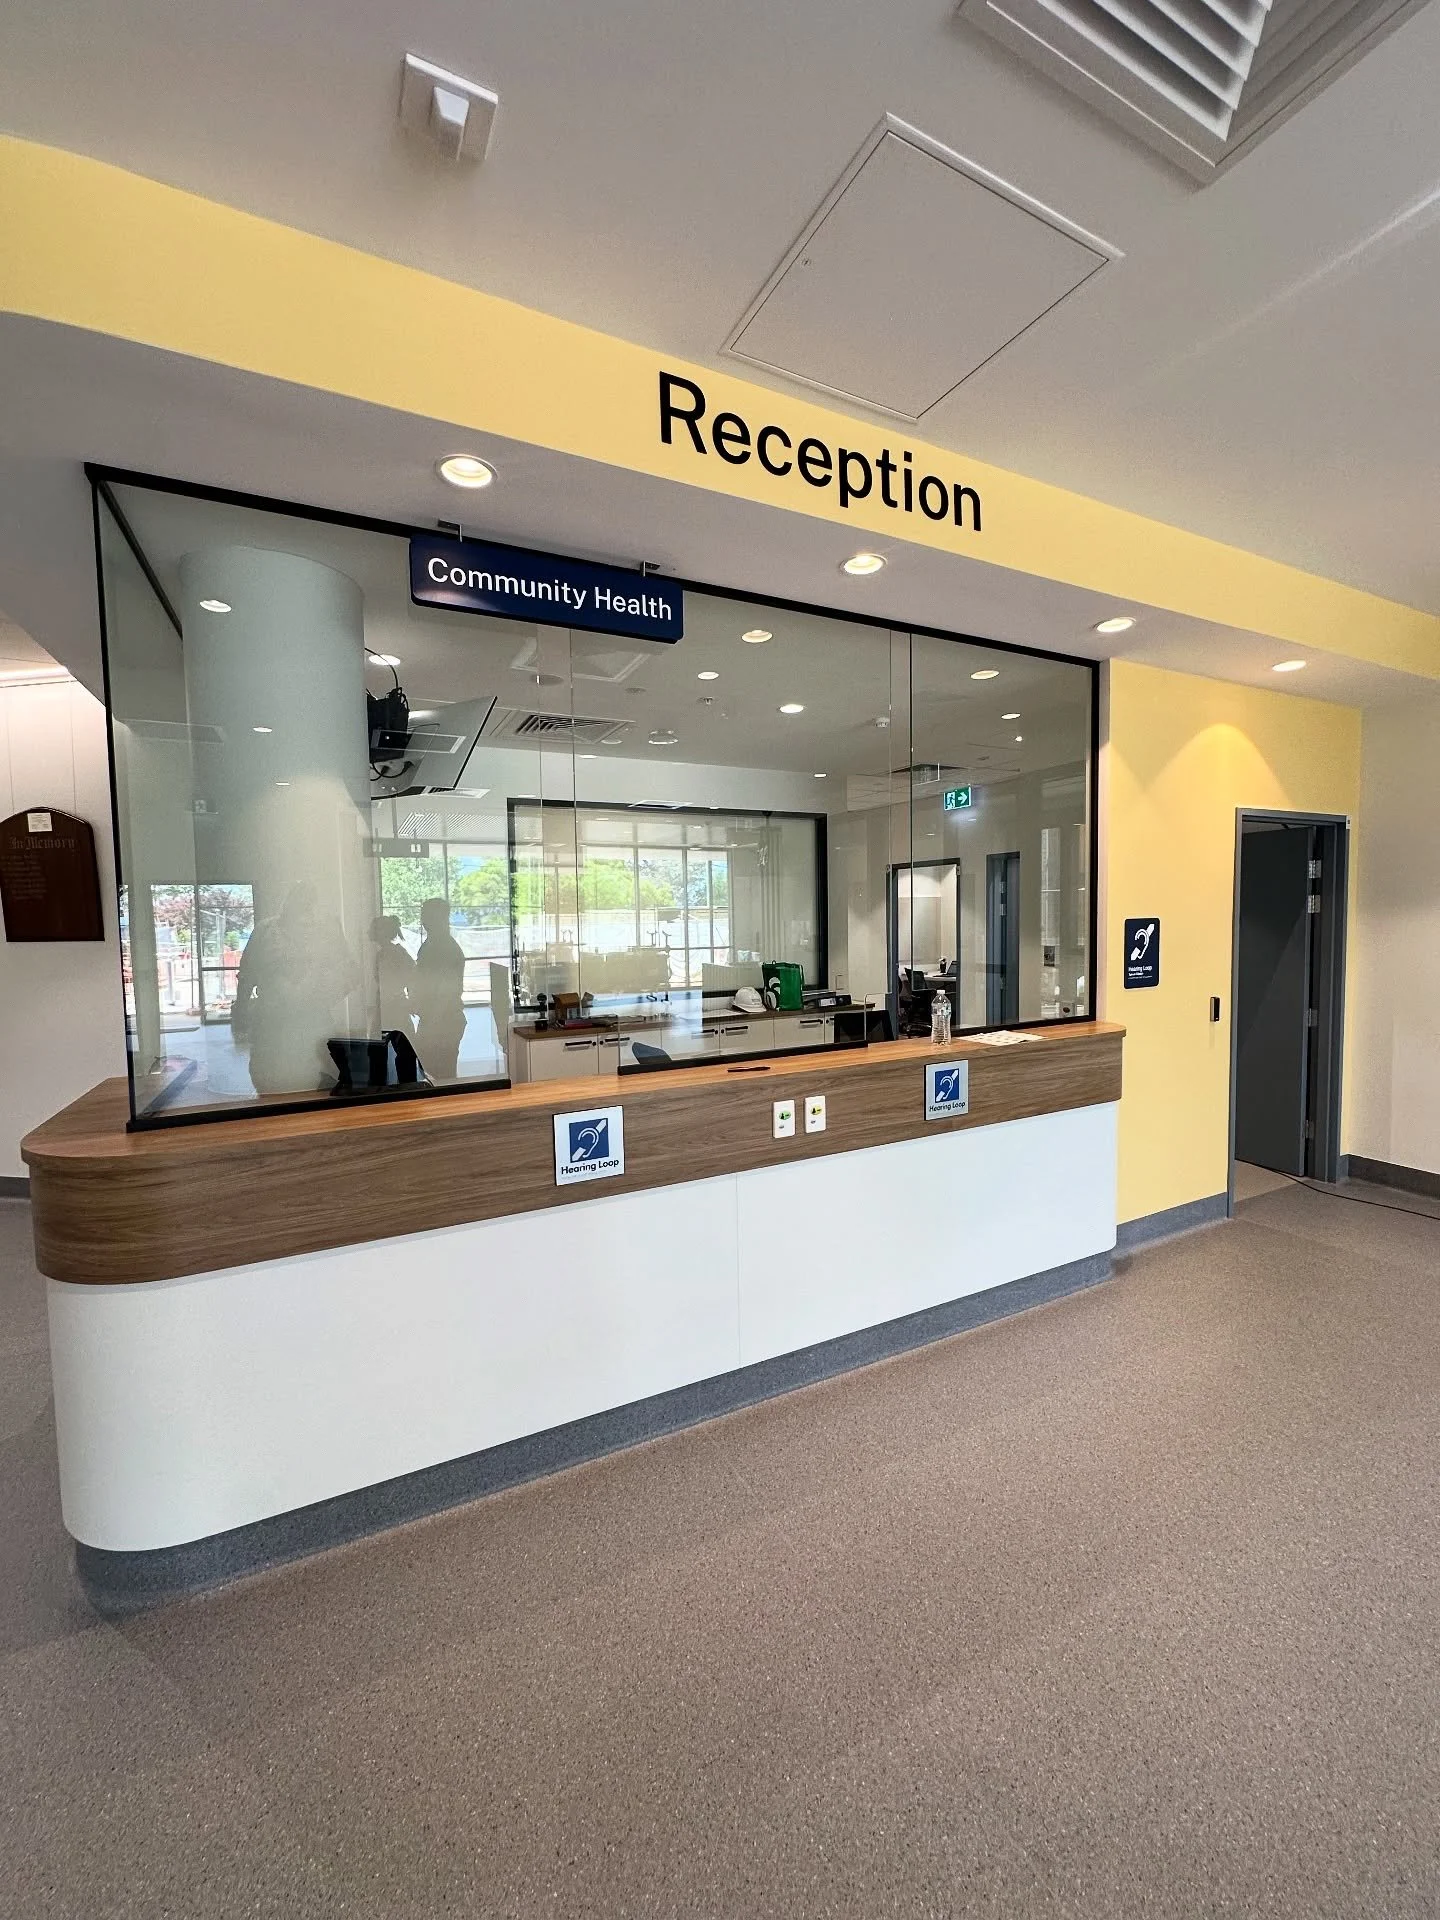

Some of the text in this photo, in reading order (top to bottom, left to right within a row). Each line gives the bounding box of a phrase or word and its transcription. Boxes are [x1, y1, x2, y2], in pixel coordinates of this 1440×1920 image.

[659, 370, 983, 532] Reception
[427, 557, 672, 621] Community Health
[24, 836, 76, 852] Memory
[929, 1101, 966, 1112] Hearing Loop
[561, 1163, 596, 1175] Hearing
[598, 1159, 620, 1169] Loop
